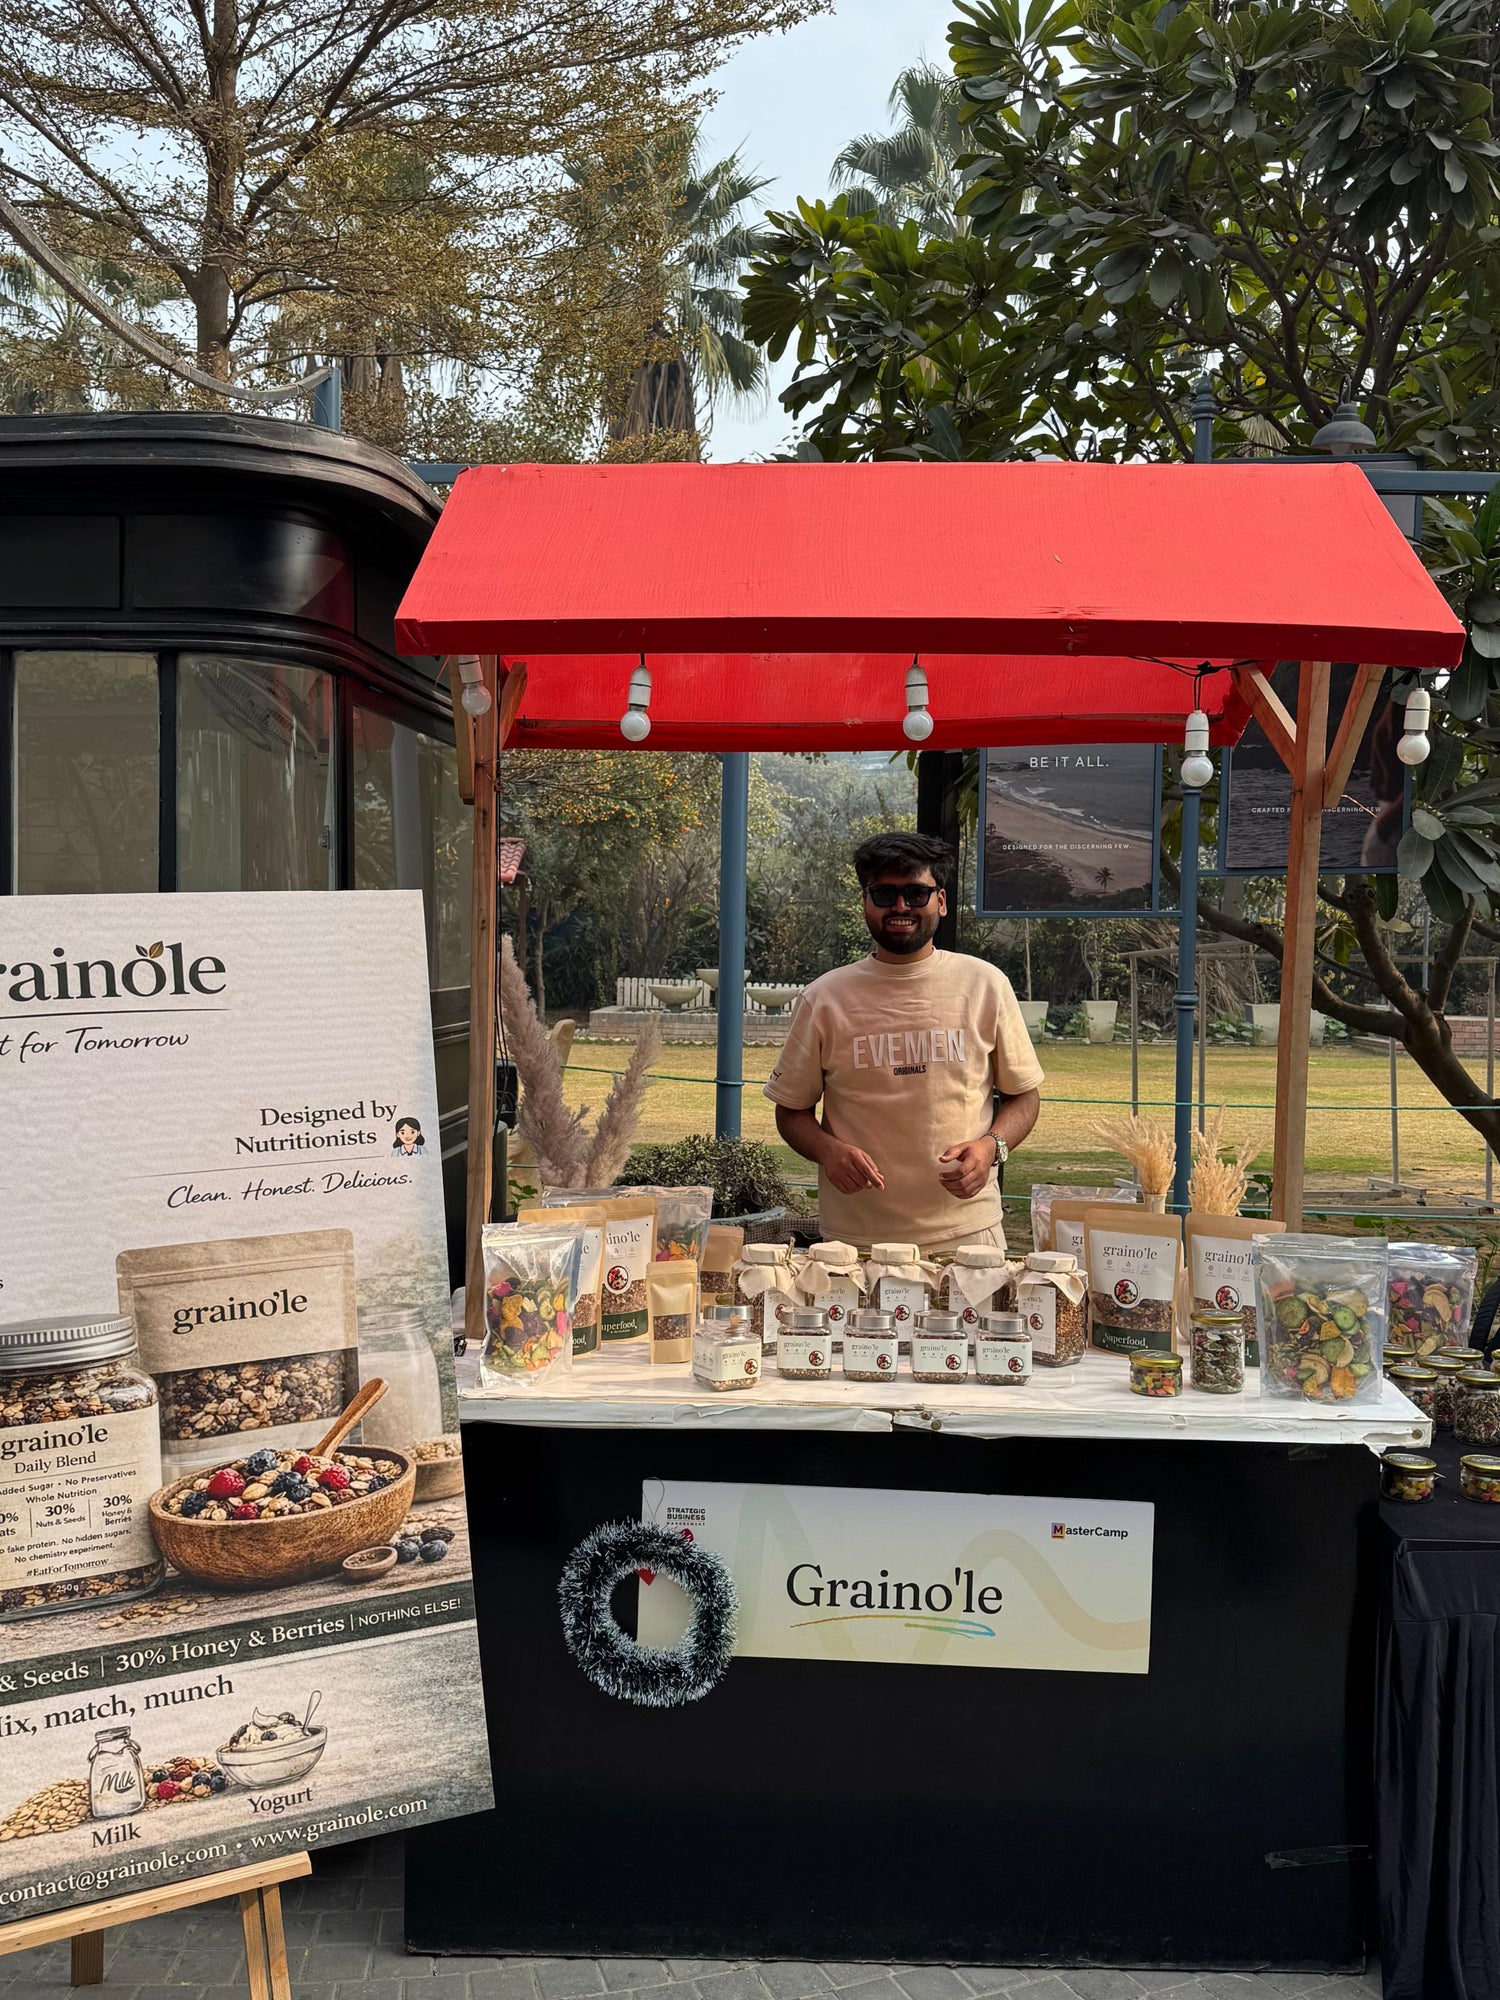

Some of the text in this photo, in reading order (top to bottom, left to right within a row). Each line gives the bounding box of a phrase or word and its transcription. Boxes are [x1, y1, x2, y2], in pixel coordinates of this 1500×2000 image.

[1029, 755, 1110, 768] BE IT ALL.
[0, 941, 227, 1003] ainole
[20, 1031, 59, 1064] for
[65, 1026, 190, 1054] Tomorrow
[853, 1029, 966, 1069] EVEMEN
[893, 1065, 927, 1076] ORIGINALS
[260, 1099, 398, 1128] Designed by
[235, 1128, 377, 1155] Nutritionists
[166, 1170, 413, 1209] Clean. Honest. Delicious.
[605, 1231, 641, 1245] ino'le
[1102, 1245, 1158, 1260] graino'le
[172, 1288, 308, 1335] graino'le
[1104, 1333, 1147, 1347] Superfood
[0, 1423, 108, 1460] graino'le
[14, 1451, 97, 1474] Daily Blend
[28, 1482, 54, 1492] Sugar
[65, 1478, 79, 1486] No
[81, 1469, 137, 1484] Preservatives
[25, 1487, 97, 1504] Whole Nutrition
[45, 1503, 75, 1517] 30%
[103, 1494, 133, 1508] 30%
[36, 1520, 53, 1528] Nuts
[63, 1516, 86, 1525] Seeds
[105, 1516, 132, 1526] Berries
[667, 1513, 706, 1521] BUSINESS
[1051, 1523, 1128, 1540] MasterCamp
[7, 1545, 25, 1554] fake
[27, 1540, 58, 1551] protein.
[75, 1533, 103, 1543] hidden
[29, 1550, 67, 1561] chemistry
[26, 1558, 109, 1577] #EatForTomorrow
[56, 1584, 79, 1593] 250 g
[786, 1563, 1003, 1615] Graino'le
[0, 1597, 462, 1692] & Seeds 30% Honey & Berries NOTHING ELSE!
[0, 1674, 234, 1737] ix, match, munch
[100, 1771, 136, 1794] Milk
[247, 1787, 314, 1815] Yogurt
[91, 1822, 142, 1848] Milk
[0, 1798, 429, 1905] contact@grainole.com www.grainole.com
